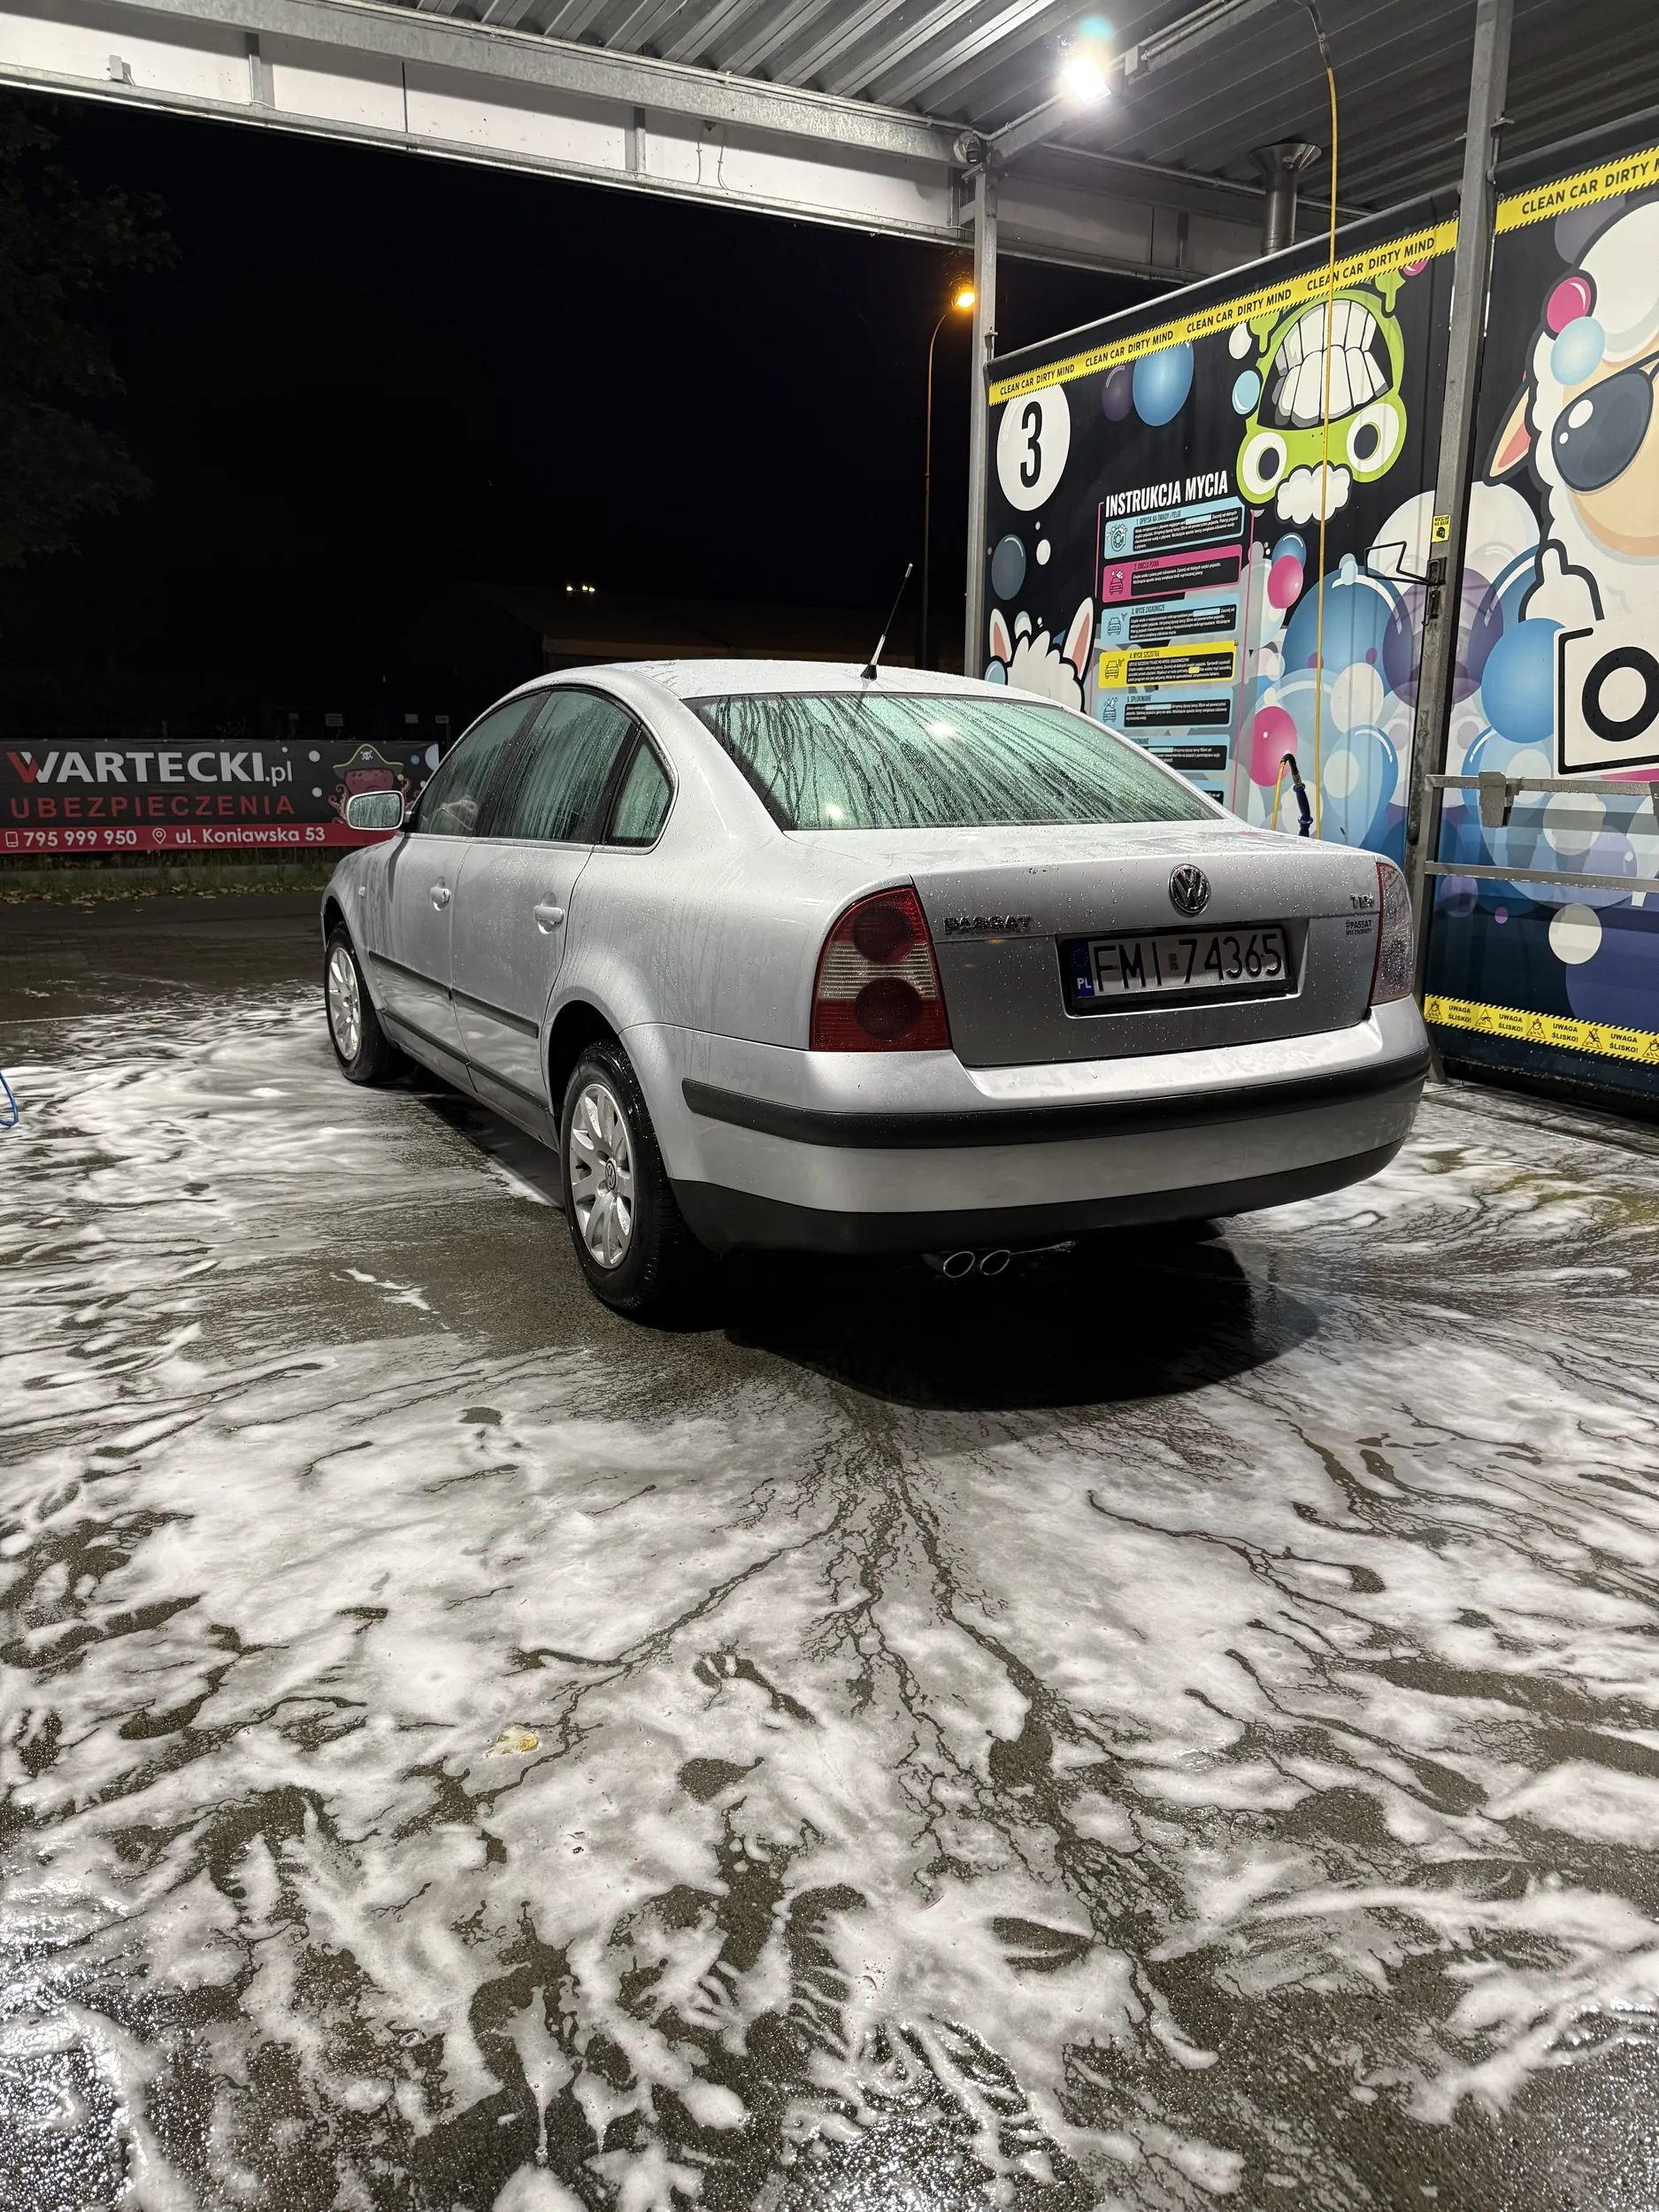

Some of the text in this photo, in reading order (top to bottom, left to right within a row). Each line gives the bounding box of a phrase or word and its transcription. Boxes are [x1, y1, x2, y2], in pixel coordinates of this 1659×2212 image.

[1522, 189, 1565, 215] CLEAN
[1570, 179, 1598, 199] CAR
[1604, 161, 1650, 188] DIRTY
[1000, 237, 1434, 396] CLEAN CAR DIRTY MIND CLEAN CAR DIRTY MIND CLEAN CAR DIRTY MIND CLEAN CAR DIRTY MIND
[1020, 401, 1043, 488] 3
[1105, 470, 1228, 518] INSTRUKCJA MYCIA
[7, 752, 292, 787] WARTECKI.pl
[11, 795, 295, 818] UBEZPIECZENIA
[23, 829, 137, 847] 795 999 950
[176, 826, 326, 843] ul. Koniawska 53
[943, 915, 1032, 935] PASSAT
[1345, 919, 1372, 929] #PASSAT
[1094, 933, 1281, 992] FMI 74365
[1077, 977, 1091, 990] PL
[1448, 1005, 1471, 1014] UWAGA
[1448, 1013, 1471, 1024] ŚLISKO!
[1499, 1014, 1523, 1023] UWAGA
[1498, 1022, 1524, 1033] ŚLISKO!
[1553, 1023, 1578, 1033] UWAGA
[1552, 1032, 1578, 1042] ŚLISKO!
[1610, 1033, 1638, 1043] UWAGA
[1609, 1042, 1639, 1053] ŚLISKO!
